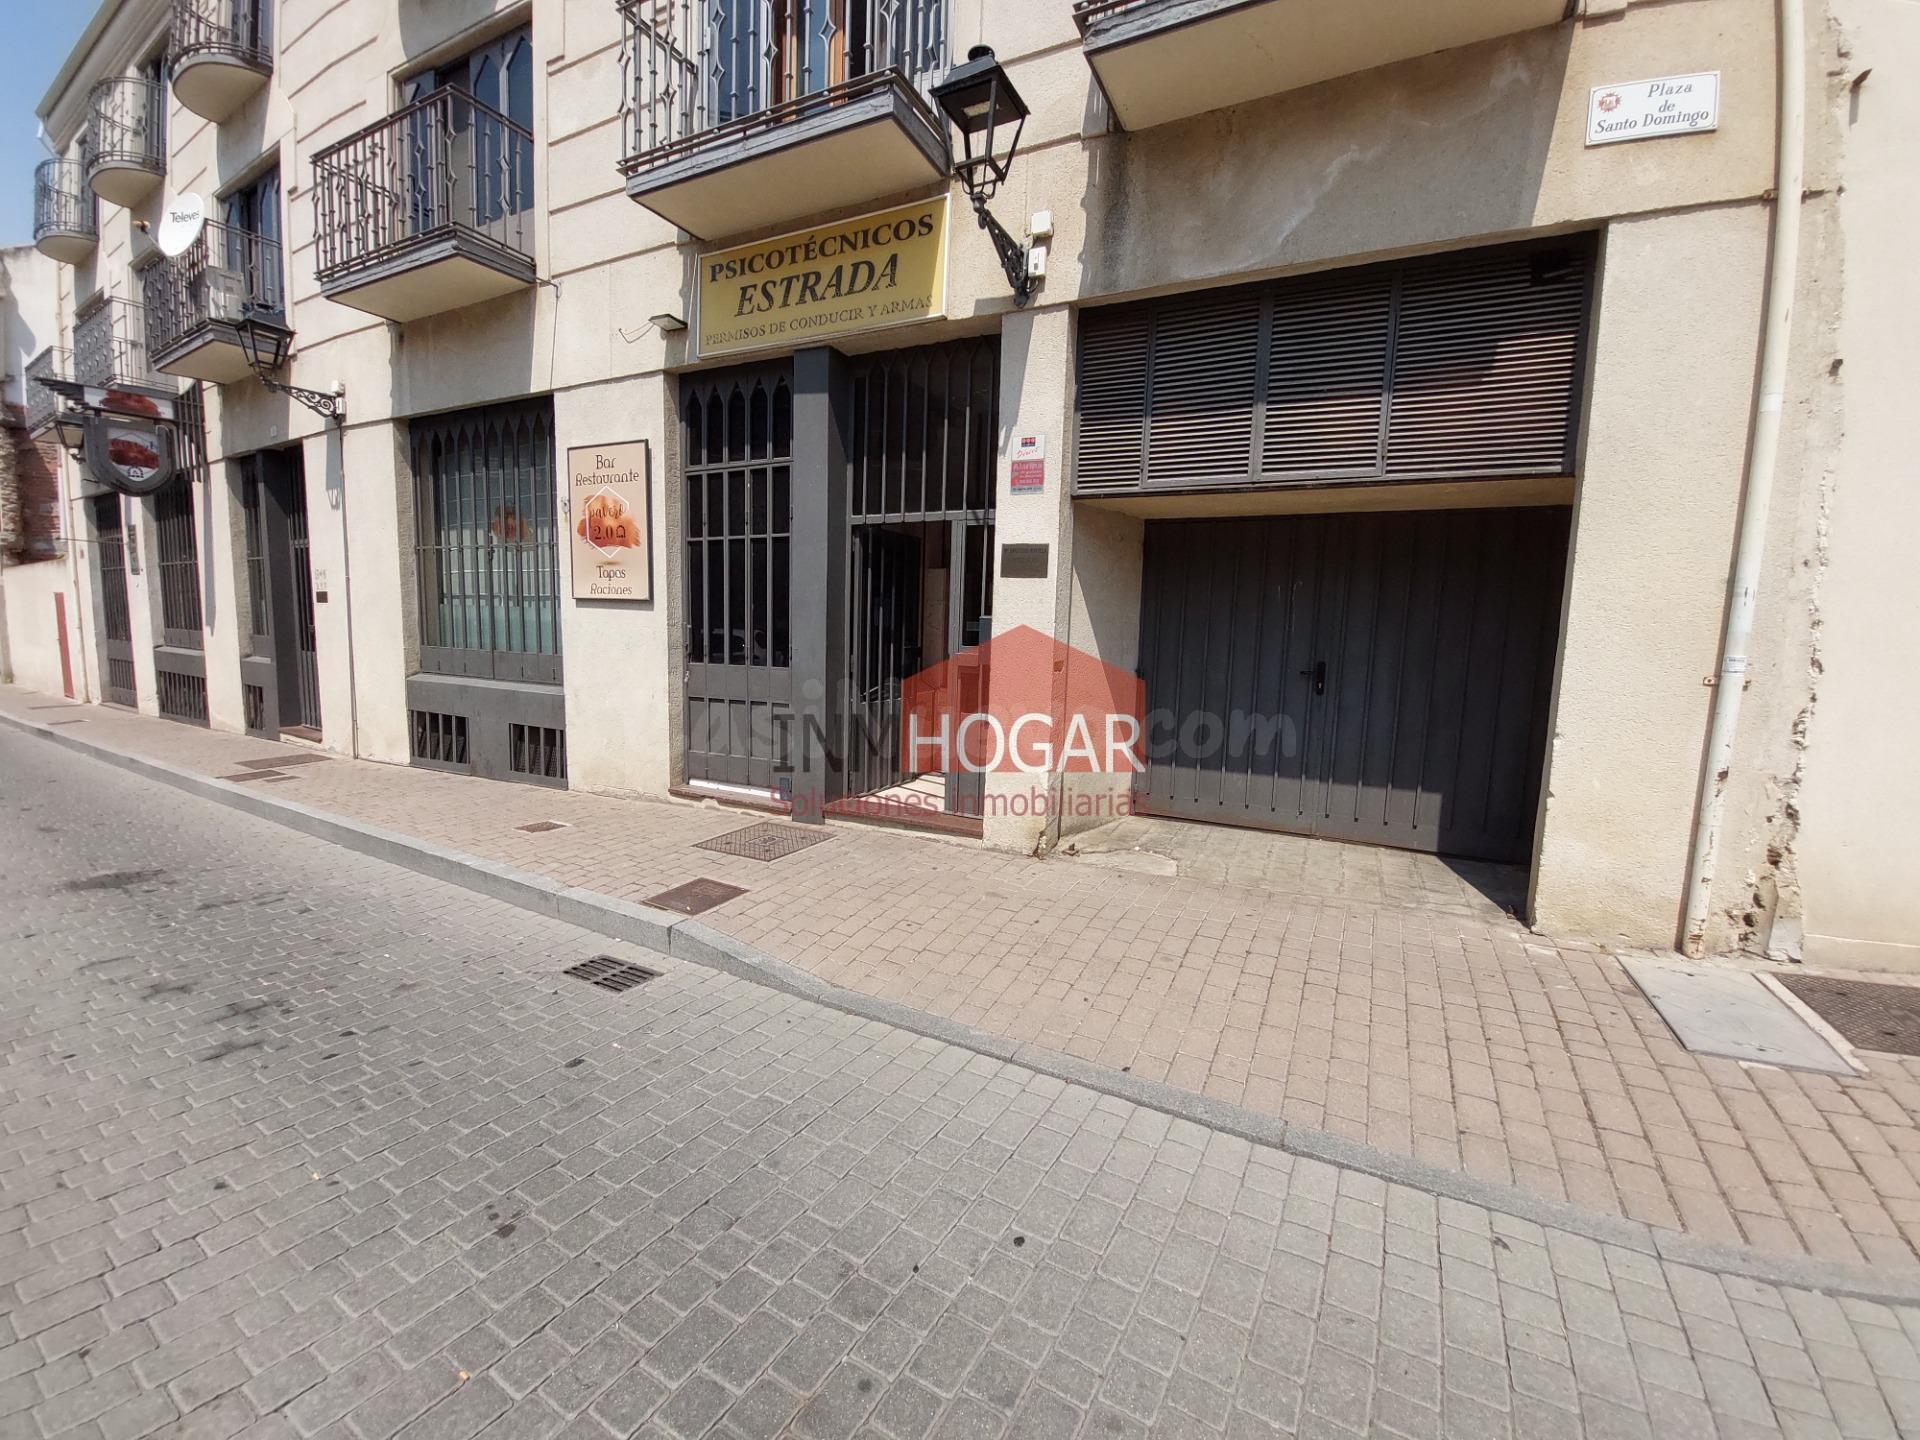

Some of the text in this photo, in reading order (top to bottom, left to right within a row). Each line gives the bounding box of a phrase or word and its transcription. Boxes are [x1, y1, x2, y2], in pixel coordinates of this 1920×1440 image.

[1648, 83, 1693, 98] Plaza
[1658, 99, 1676, 113] de
[1594, 110, 1710, 134] Santo Domingo
[709, 213, 934, 283] PSICOTÉCNICOS
[734, 252, 899, 318] ESTRADA
[705, 294, 934, 345] PERMISOS DE CONDUCIR Y ARMAS
[595, 454, 616, 470] Bar
[575, 468, 640, 487] Restaurante
[594, 525, 613, 540] 2.0
[596, 565, 626, 582] Tapas
[590, 582, 632, 595] Raciones
